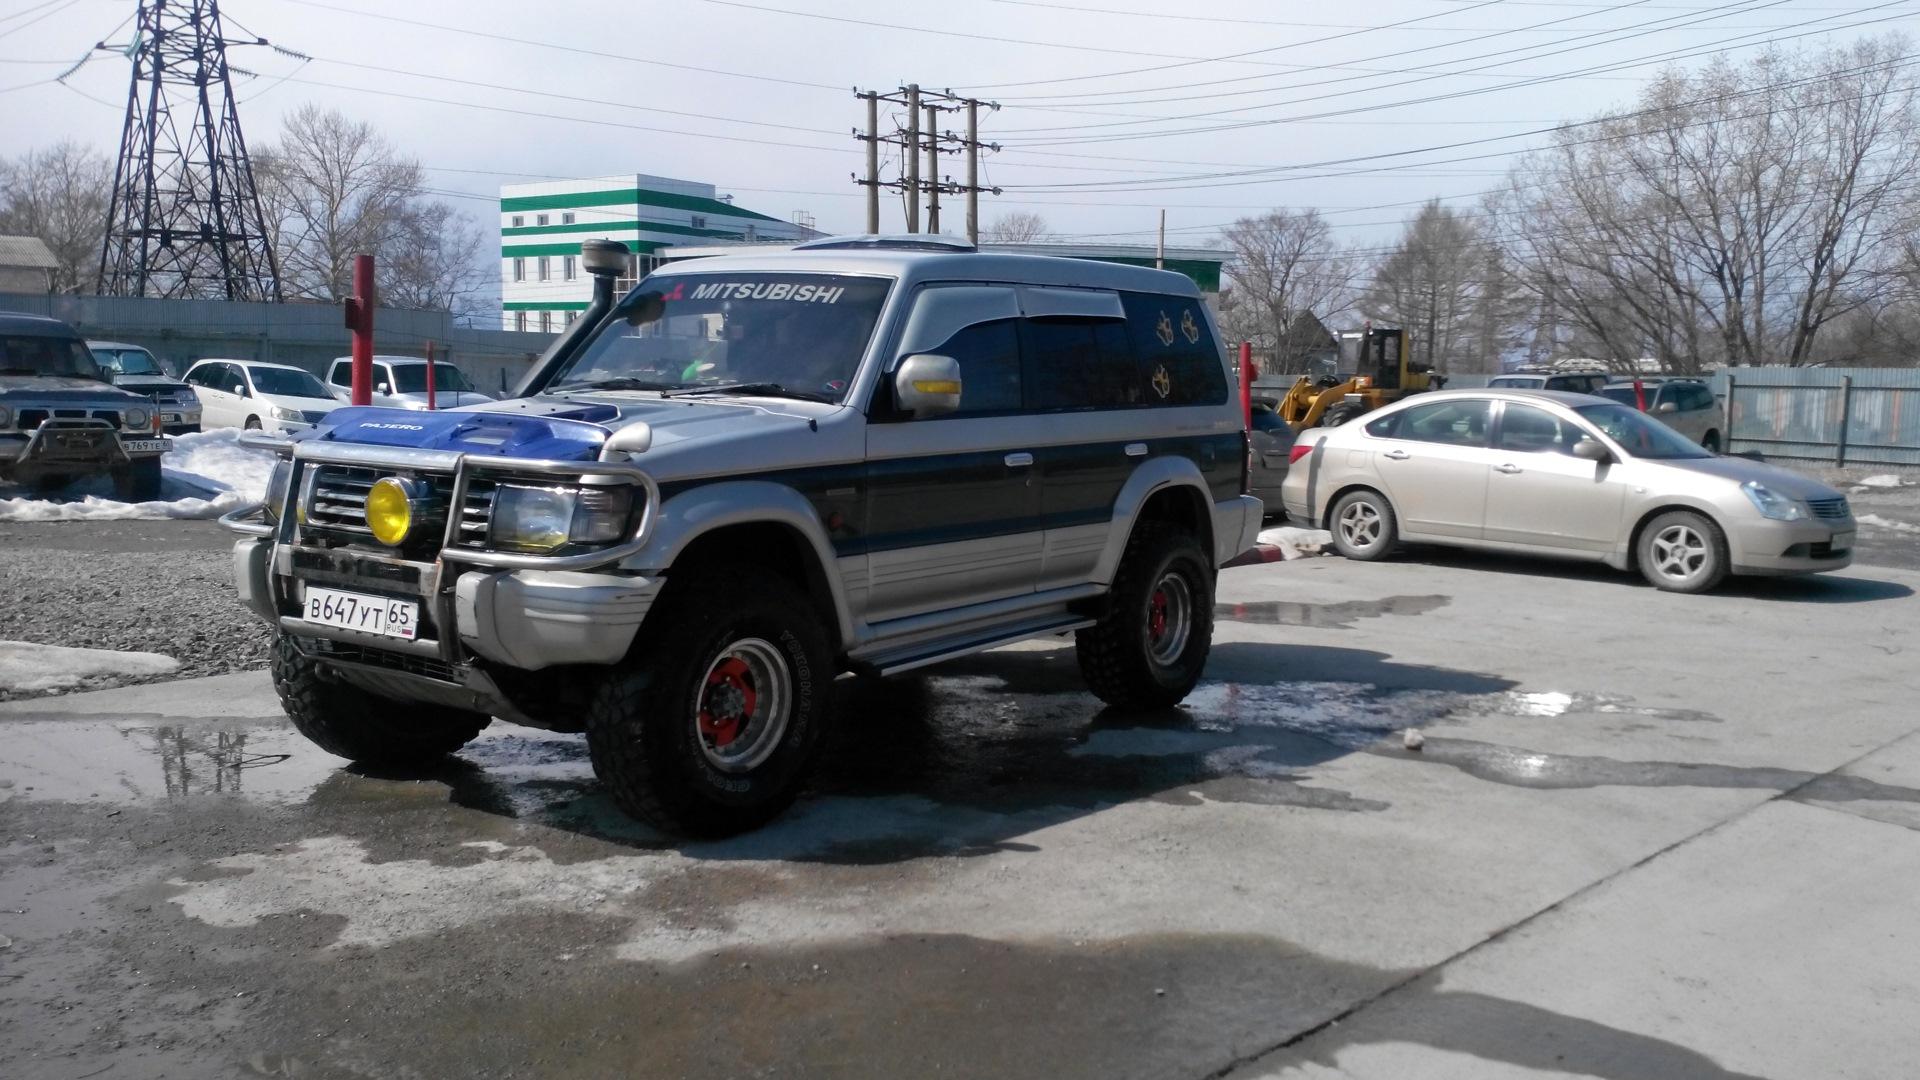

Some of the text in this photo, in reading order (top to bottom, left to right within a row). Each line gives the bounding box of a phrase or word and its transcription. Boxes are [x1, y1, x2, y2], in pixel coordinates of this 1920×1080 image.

[690, 283, 845, 304] MITSUBISHI
[360, 422, 424, 430] PAJERO
[388, 603, 410, 625] 65
[386, 623, 402, 634] RUS
